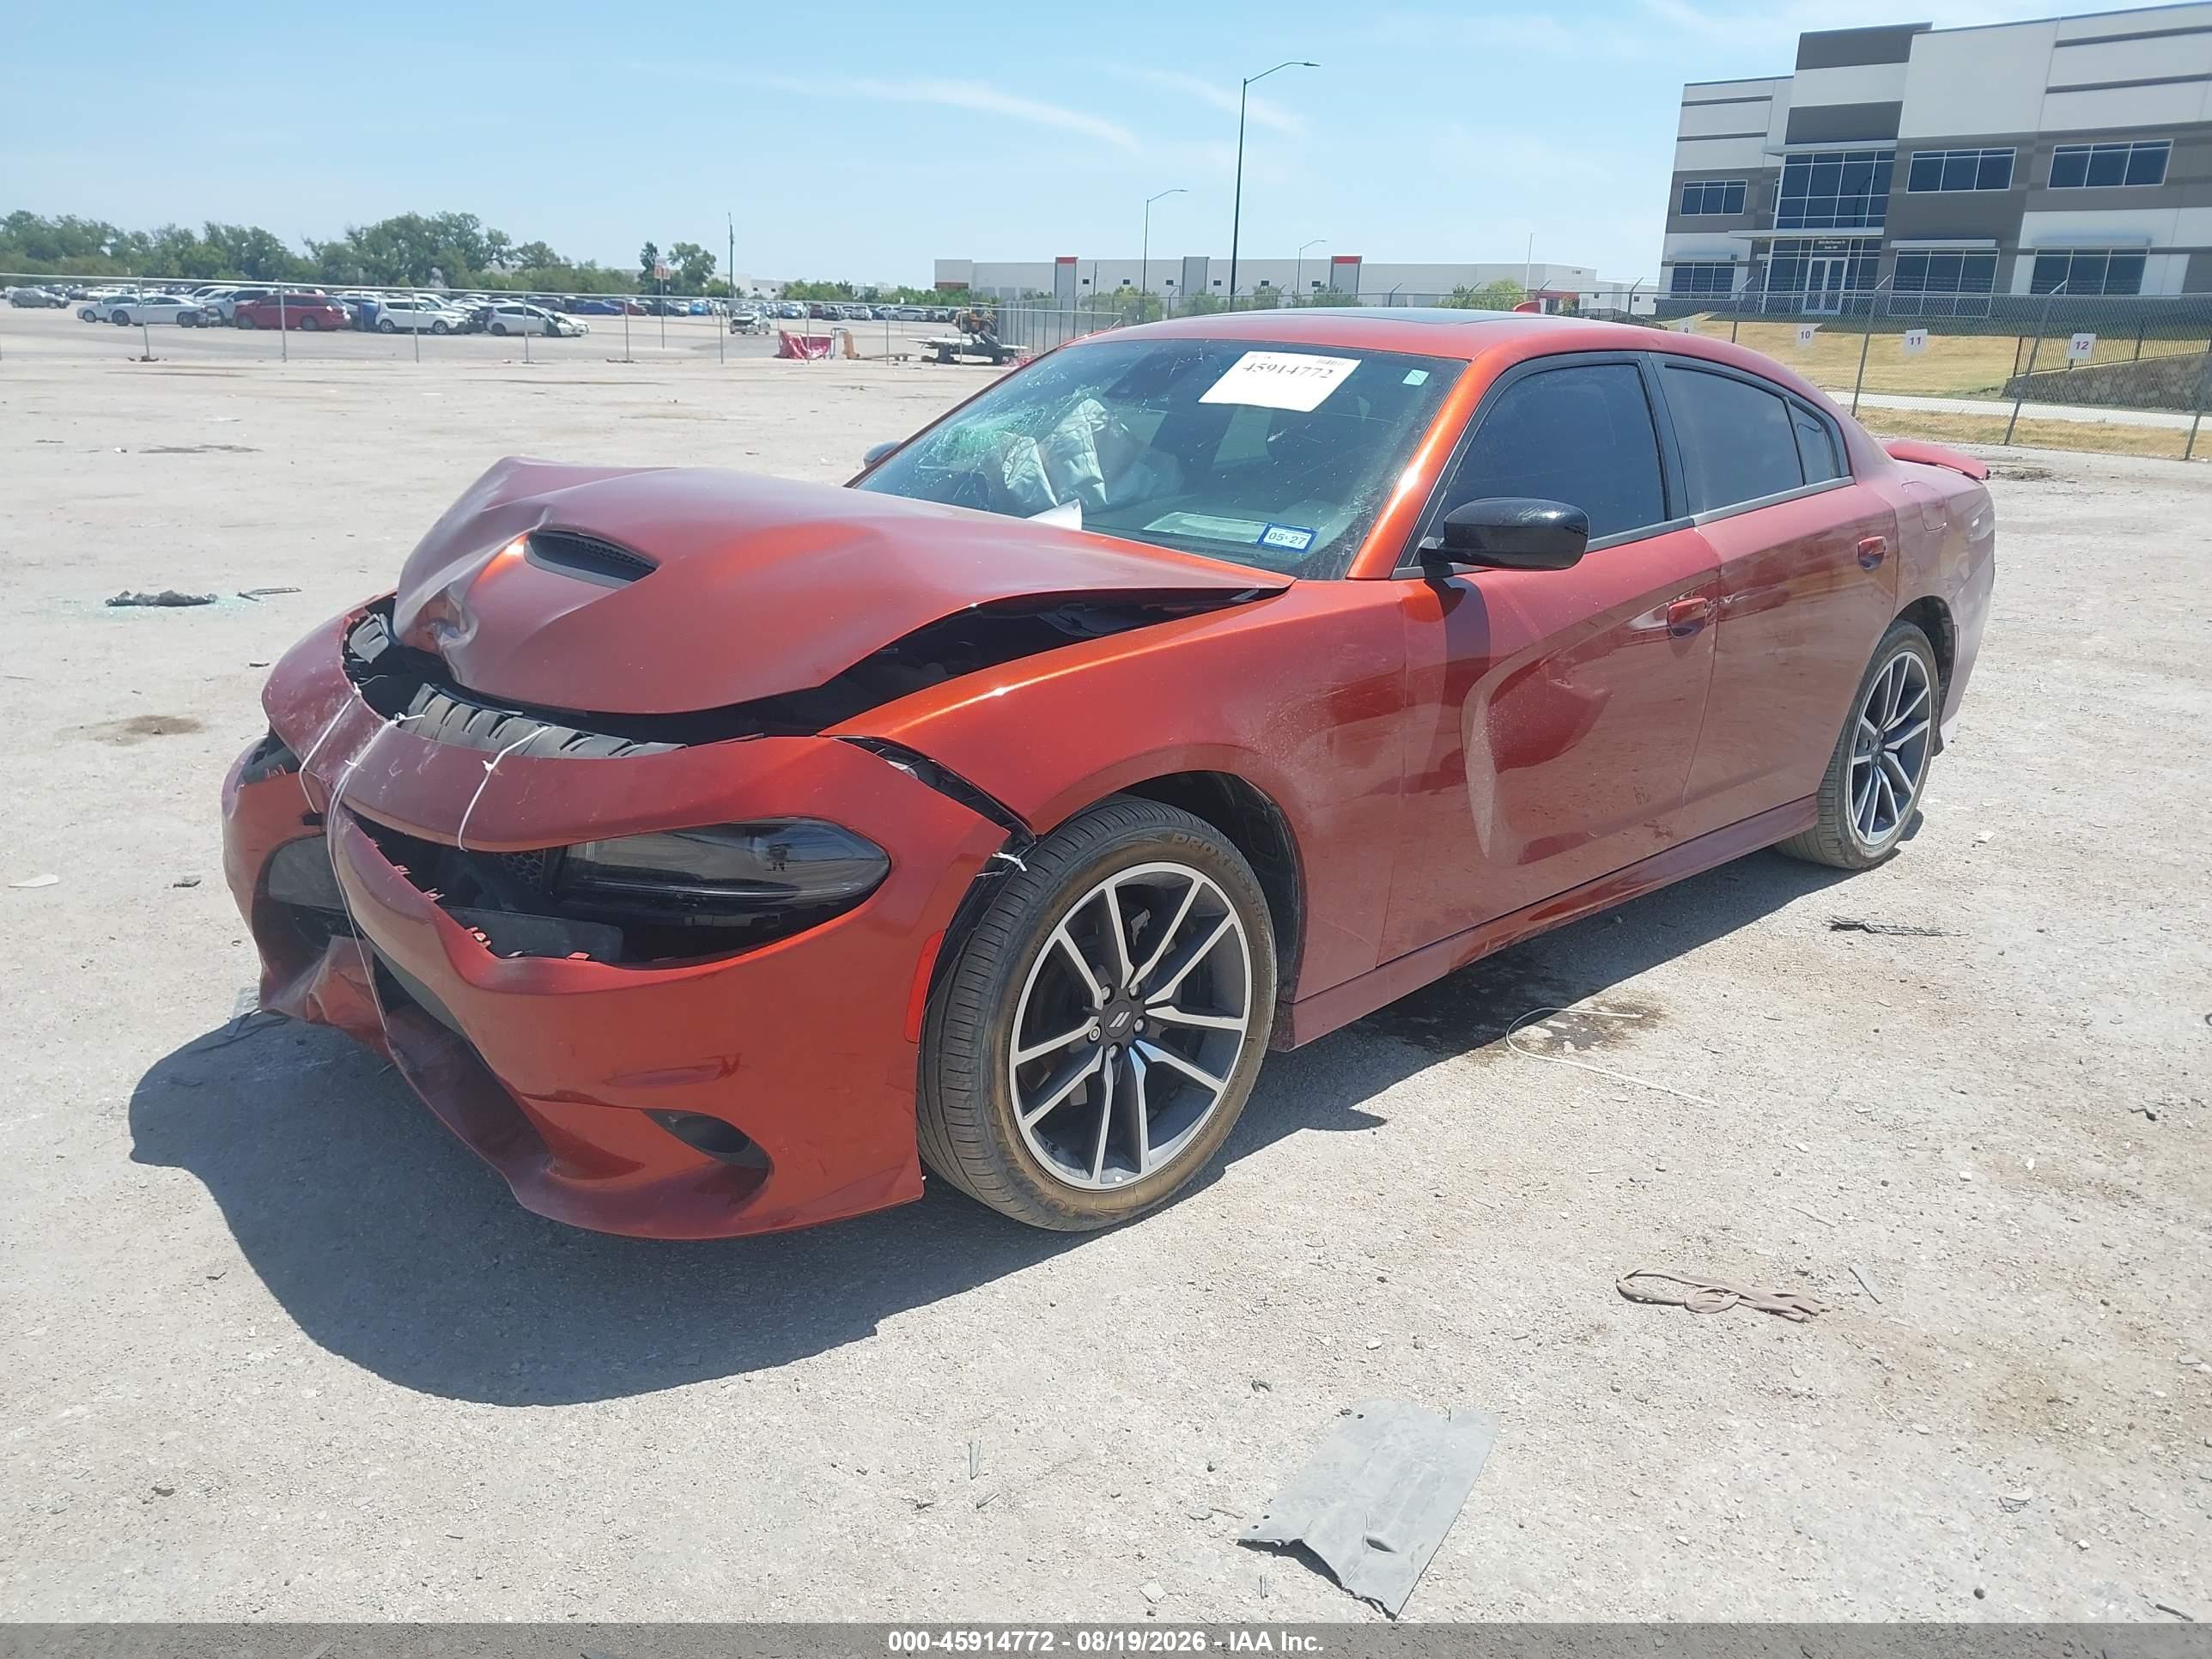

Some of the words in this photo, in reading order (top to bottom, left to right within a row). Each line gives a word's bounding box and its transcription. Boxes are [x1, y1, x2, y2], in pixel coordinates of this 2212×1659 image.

[1801, 330, 1811, 339] 10
[1909, 336, 1921, 345] 11
[2075, 340, 2089, 350] 12
[1243, 362, 1334, 379] 45914772
[1268, 532, 1285, 542] 05
[1289, 535, 1307, 545] 27
